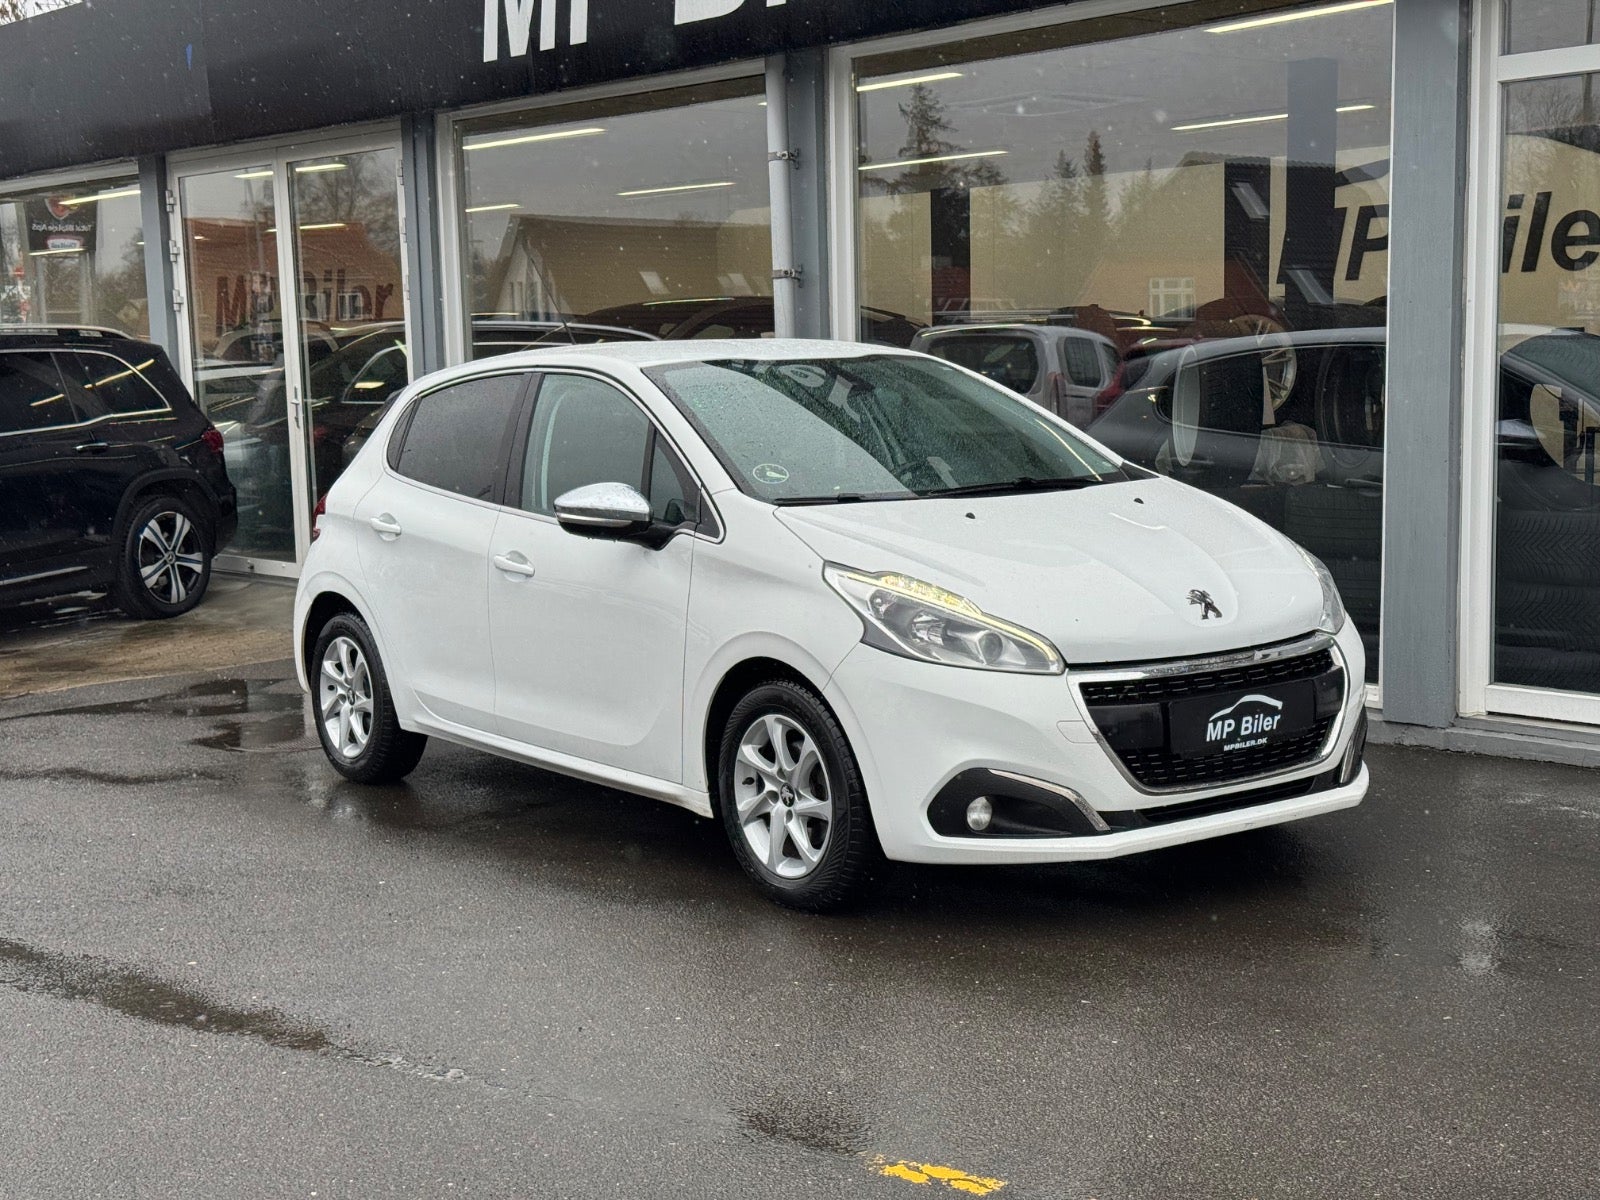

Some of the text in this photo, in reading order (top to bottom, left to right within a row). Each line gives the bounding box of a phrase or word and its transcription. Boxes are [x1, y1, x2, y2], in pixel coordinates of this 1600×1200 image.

[1206, 713, 1281, 742] MP Biler
[1223, 737, 1268, 751] MPBILER.DK
